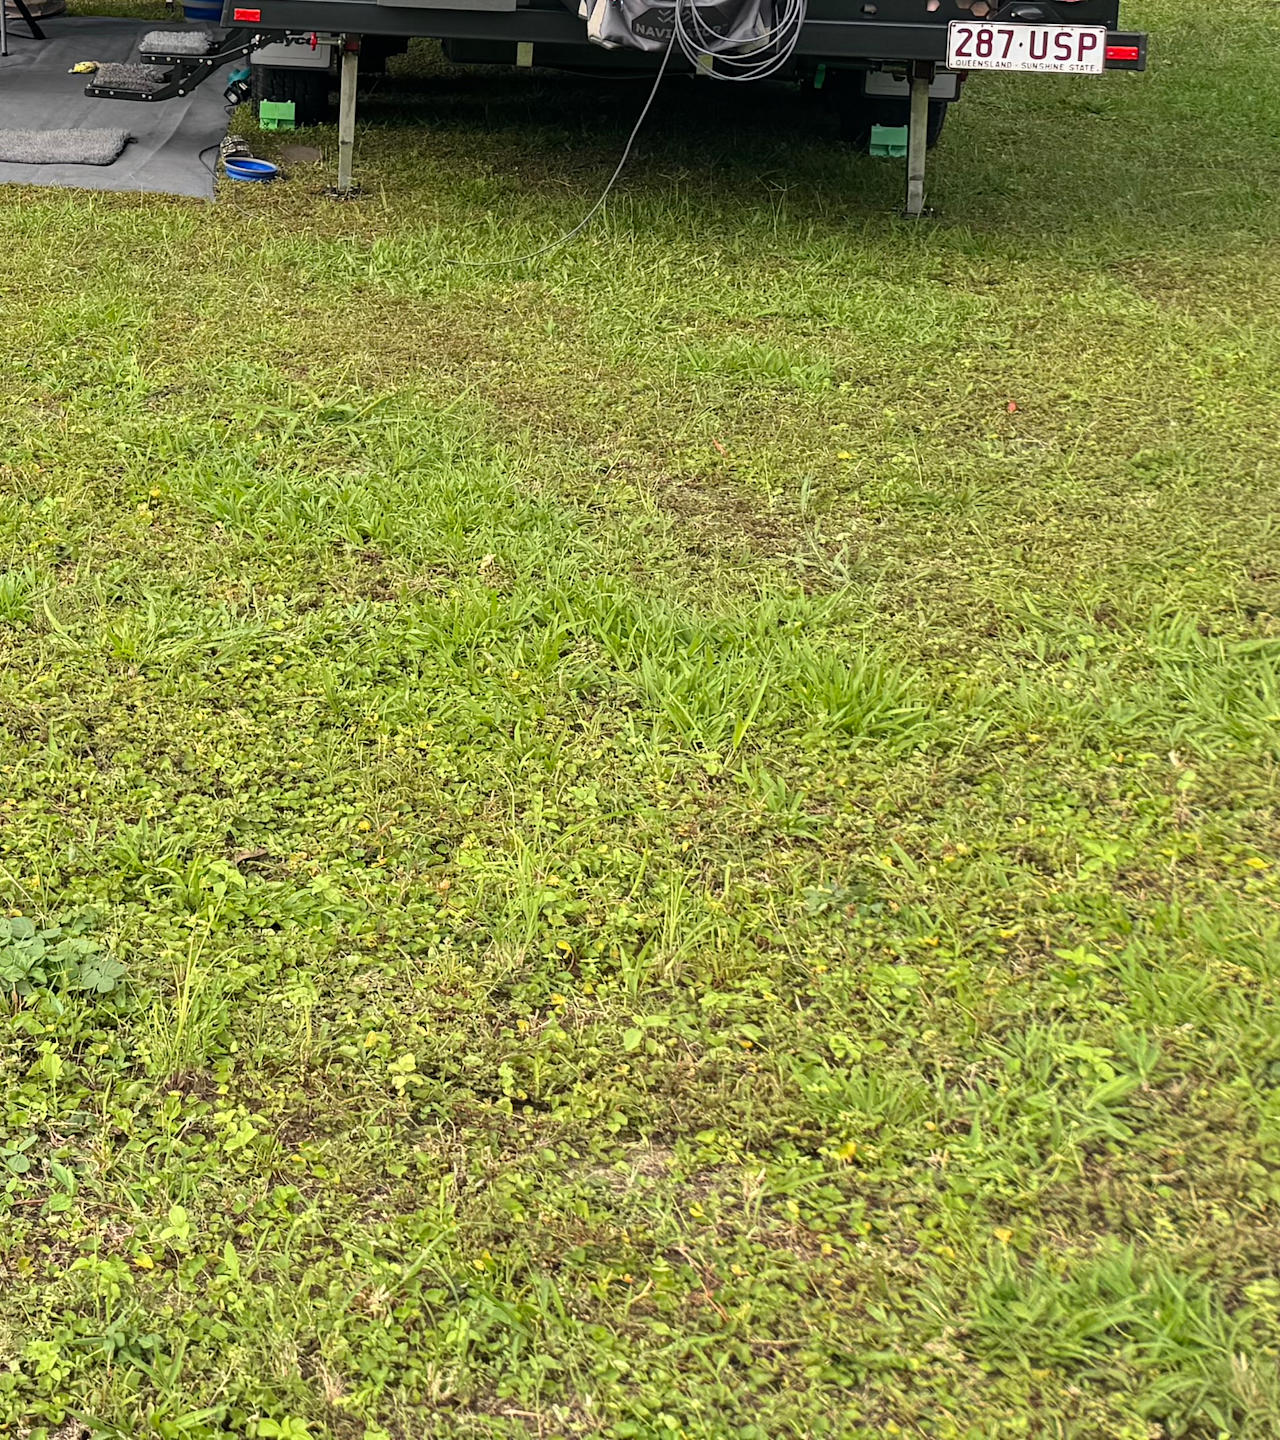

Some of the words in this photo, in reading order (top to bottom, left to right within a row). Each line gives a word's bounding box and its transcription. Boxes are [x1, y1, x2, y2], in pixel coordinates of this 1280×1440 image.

[955, 60, 1013, 69] QUEENSLAND
[1020, 62, 1064, 71] SUNSHINE
[1068, 63, 1096, 72] STATE
